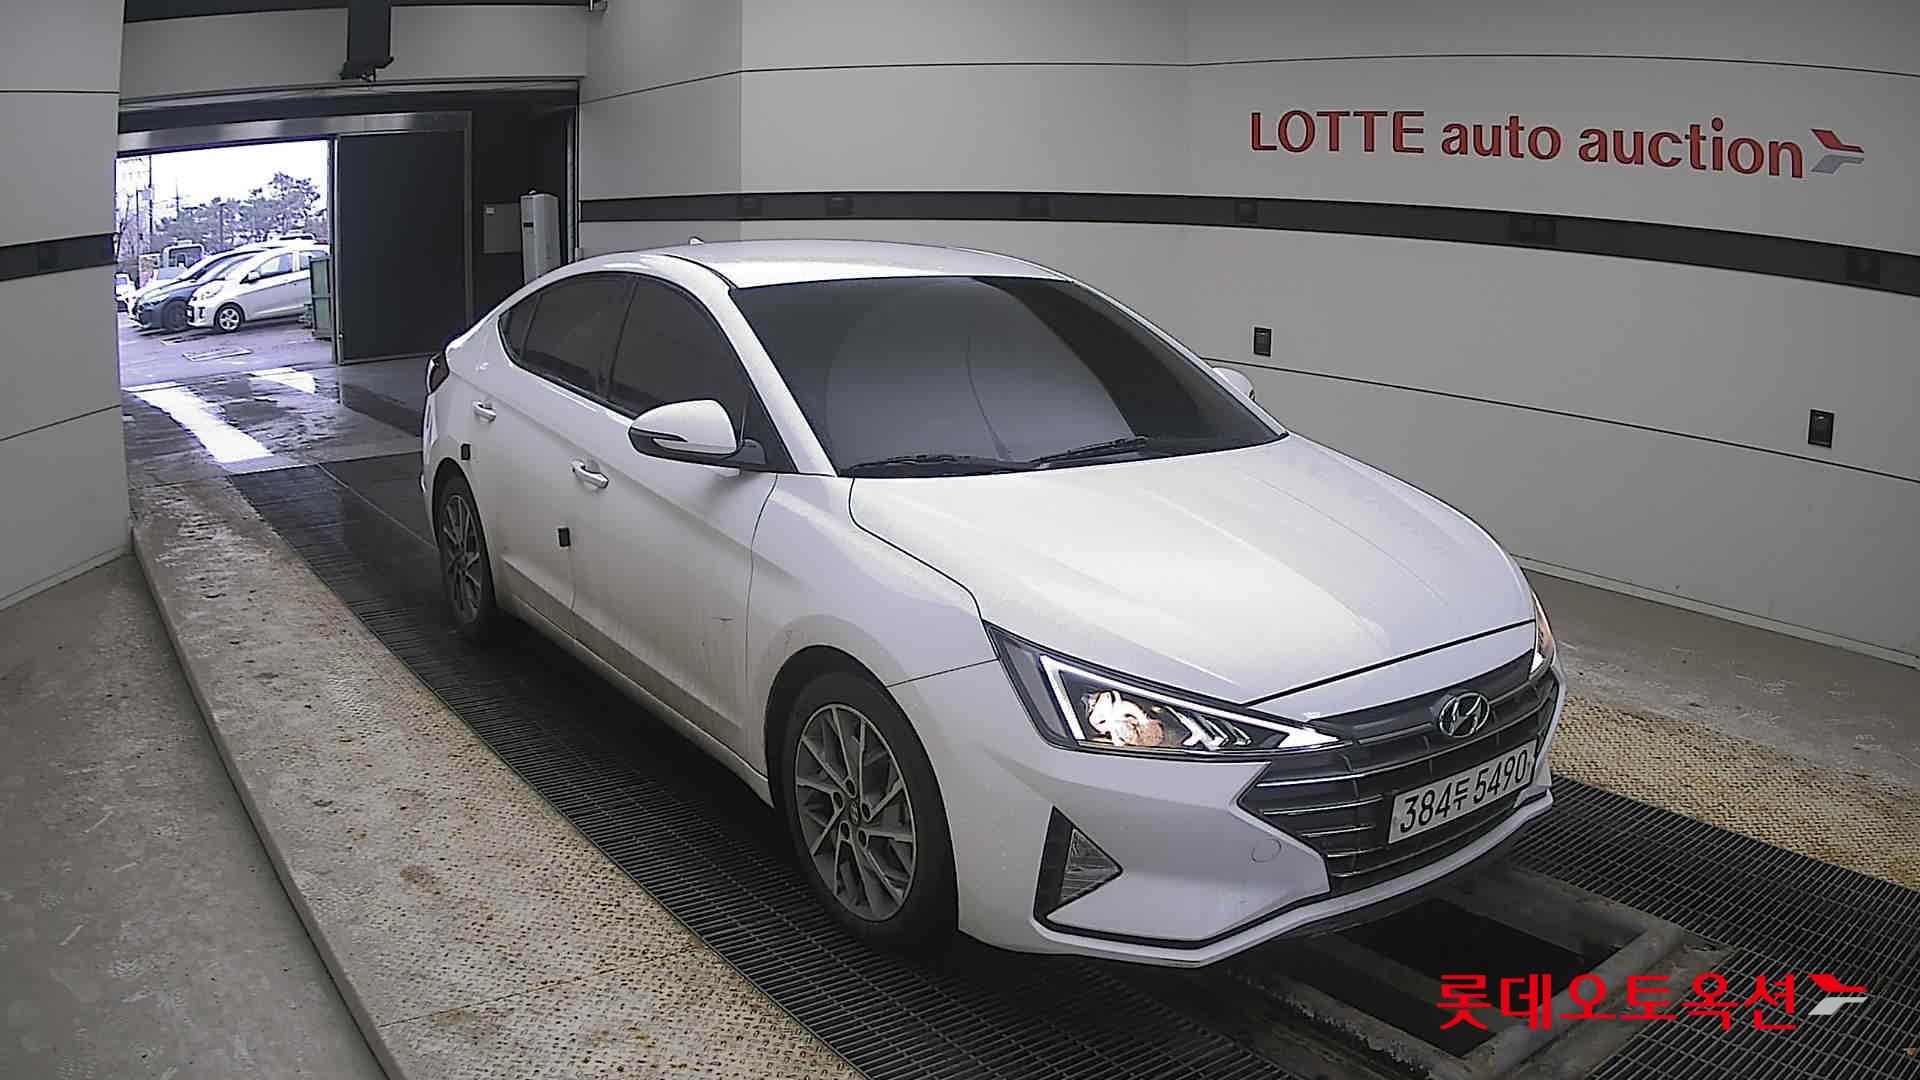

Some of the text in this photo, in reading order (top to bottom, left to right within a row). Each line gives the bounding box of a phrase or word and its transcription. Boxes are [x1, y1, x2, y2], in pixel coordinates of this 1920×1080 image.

[1251, 110, 1803, 178] LOTTE auto auction
[1473, 751, 1528, 804] 5490
